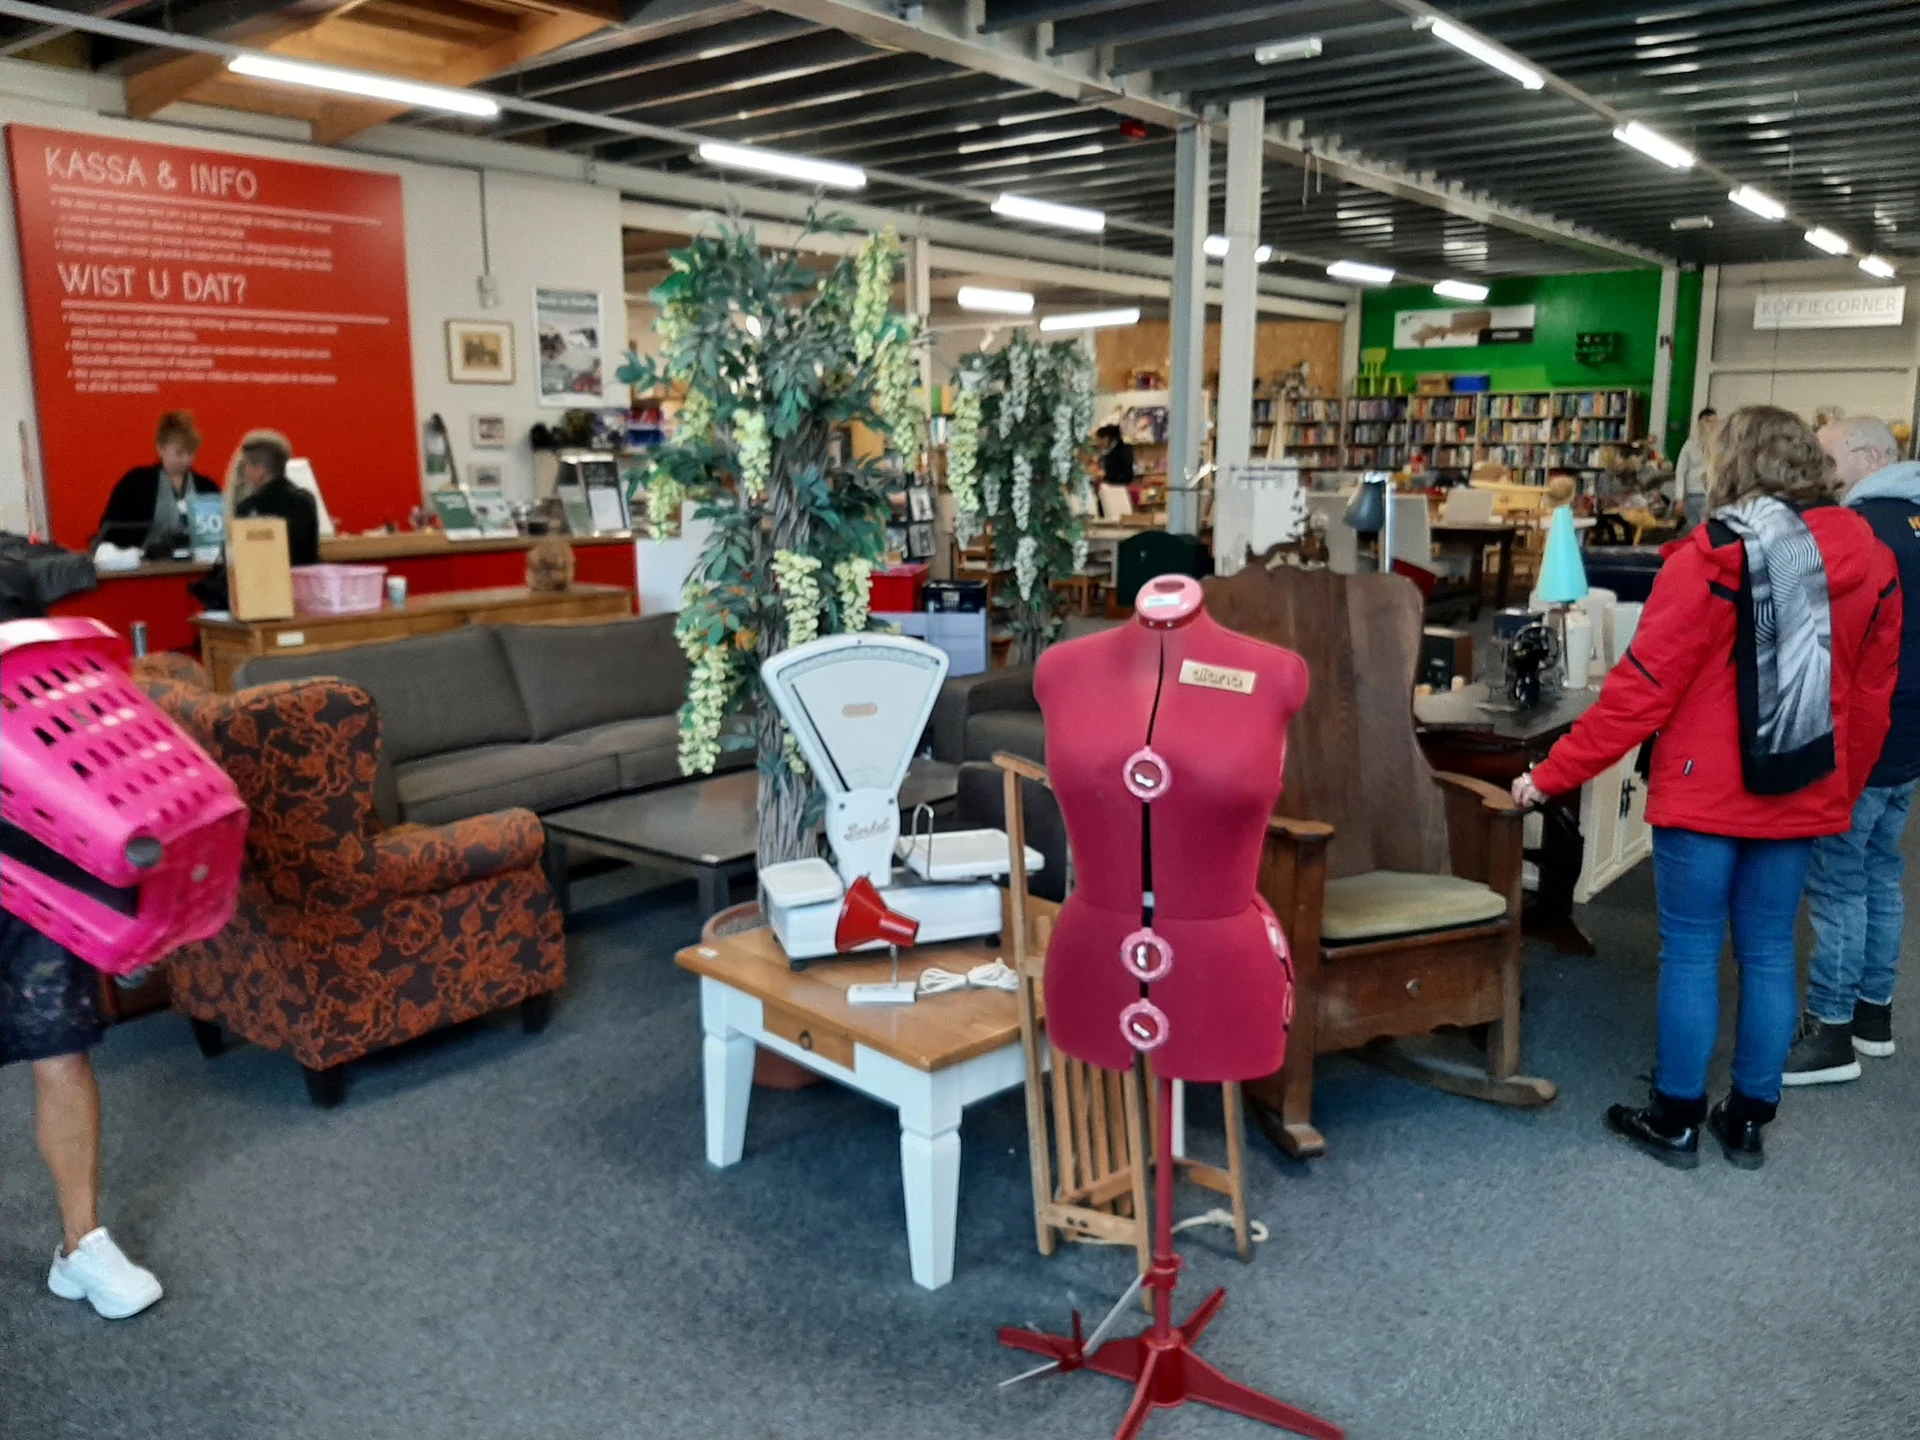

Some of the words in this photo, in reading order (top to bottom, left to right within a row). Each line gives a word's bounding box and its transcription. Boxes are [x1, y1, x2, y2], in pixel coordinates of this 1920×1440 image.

[45, 147, 147, 188] KASSA
[156, 160, 178, 191] &
[189, 163, 259, 200] INFO
[57, 262, 136, 298] WIST
[148, 268, 170, 300] U
[182, 270, 248, 304] DAT?
[1761, 295, 1897, 315] KOFFIECORNER
